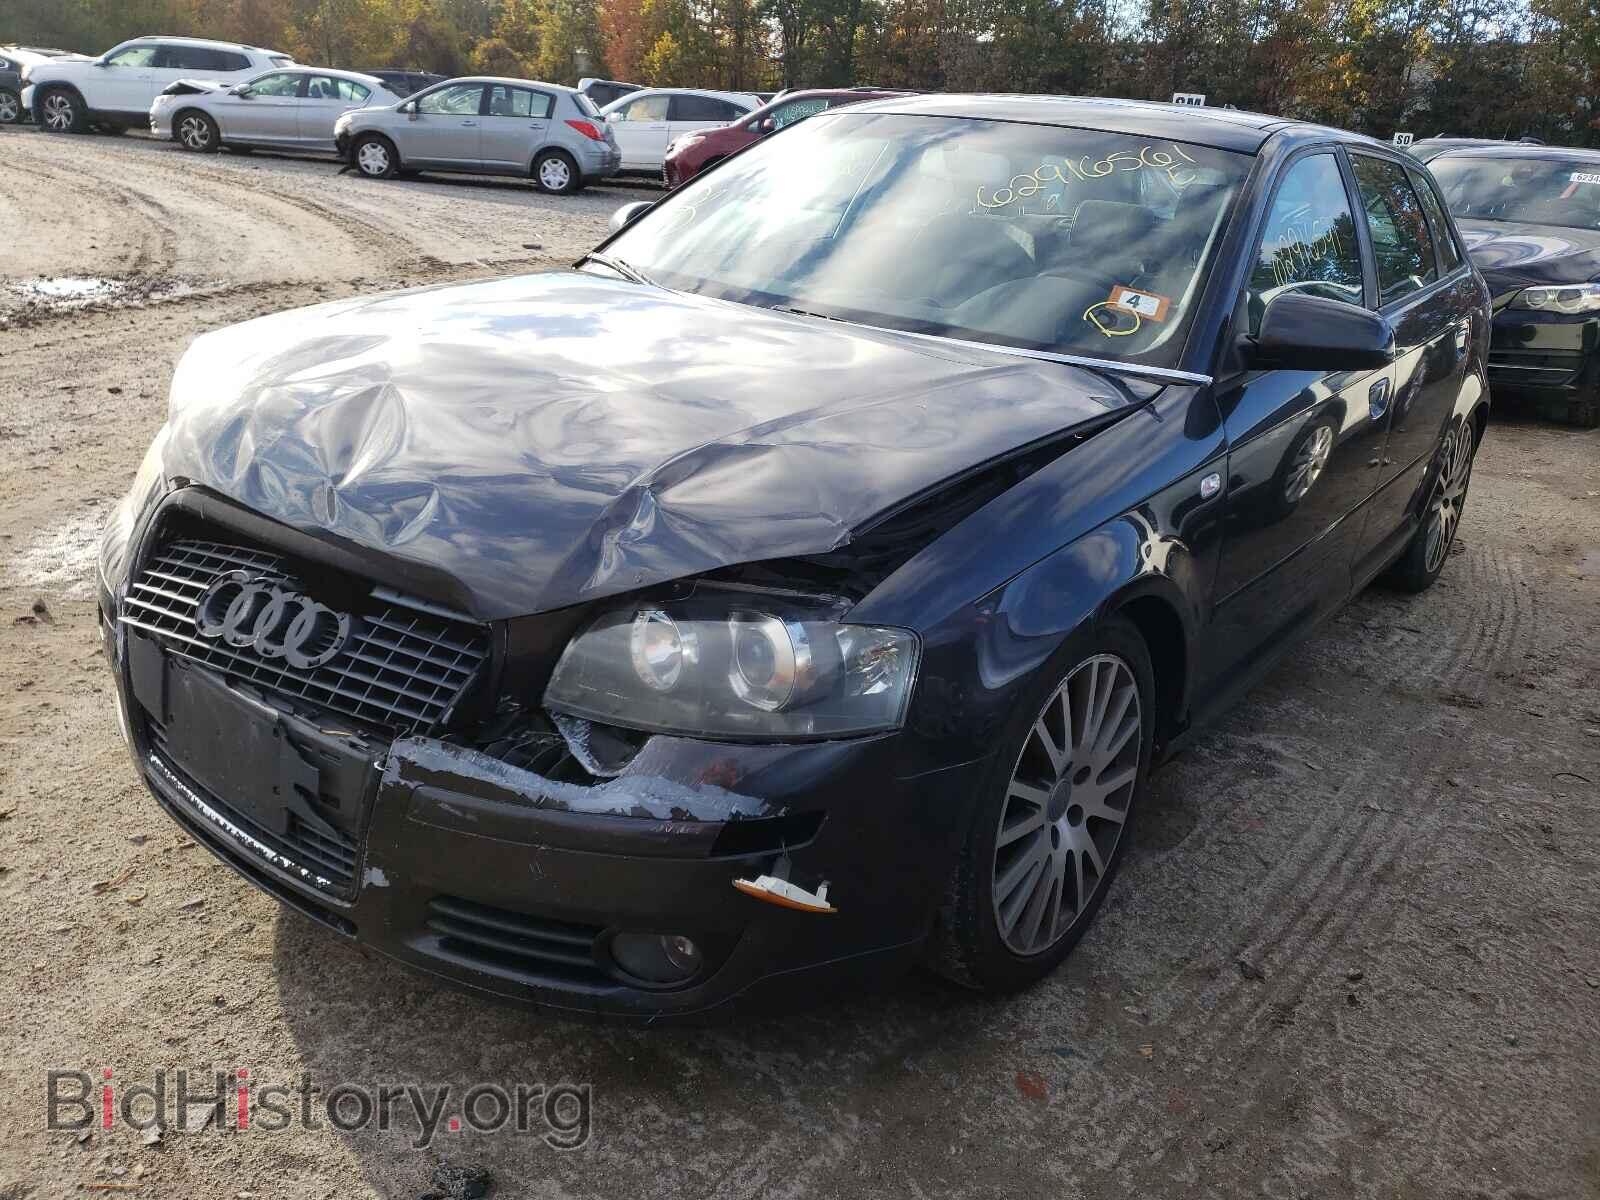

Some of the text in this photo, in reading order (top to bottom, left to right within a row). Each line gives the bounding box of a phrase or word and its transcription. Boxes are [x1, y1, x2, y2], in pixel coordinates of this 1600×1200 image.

[977, 144, 1197, 208] 62916561
[1576, 174, 1600, 184] 6234
[1126, 294, 1141, 309] 4
